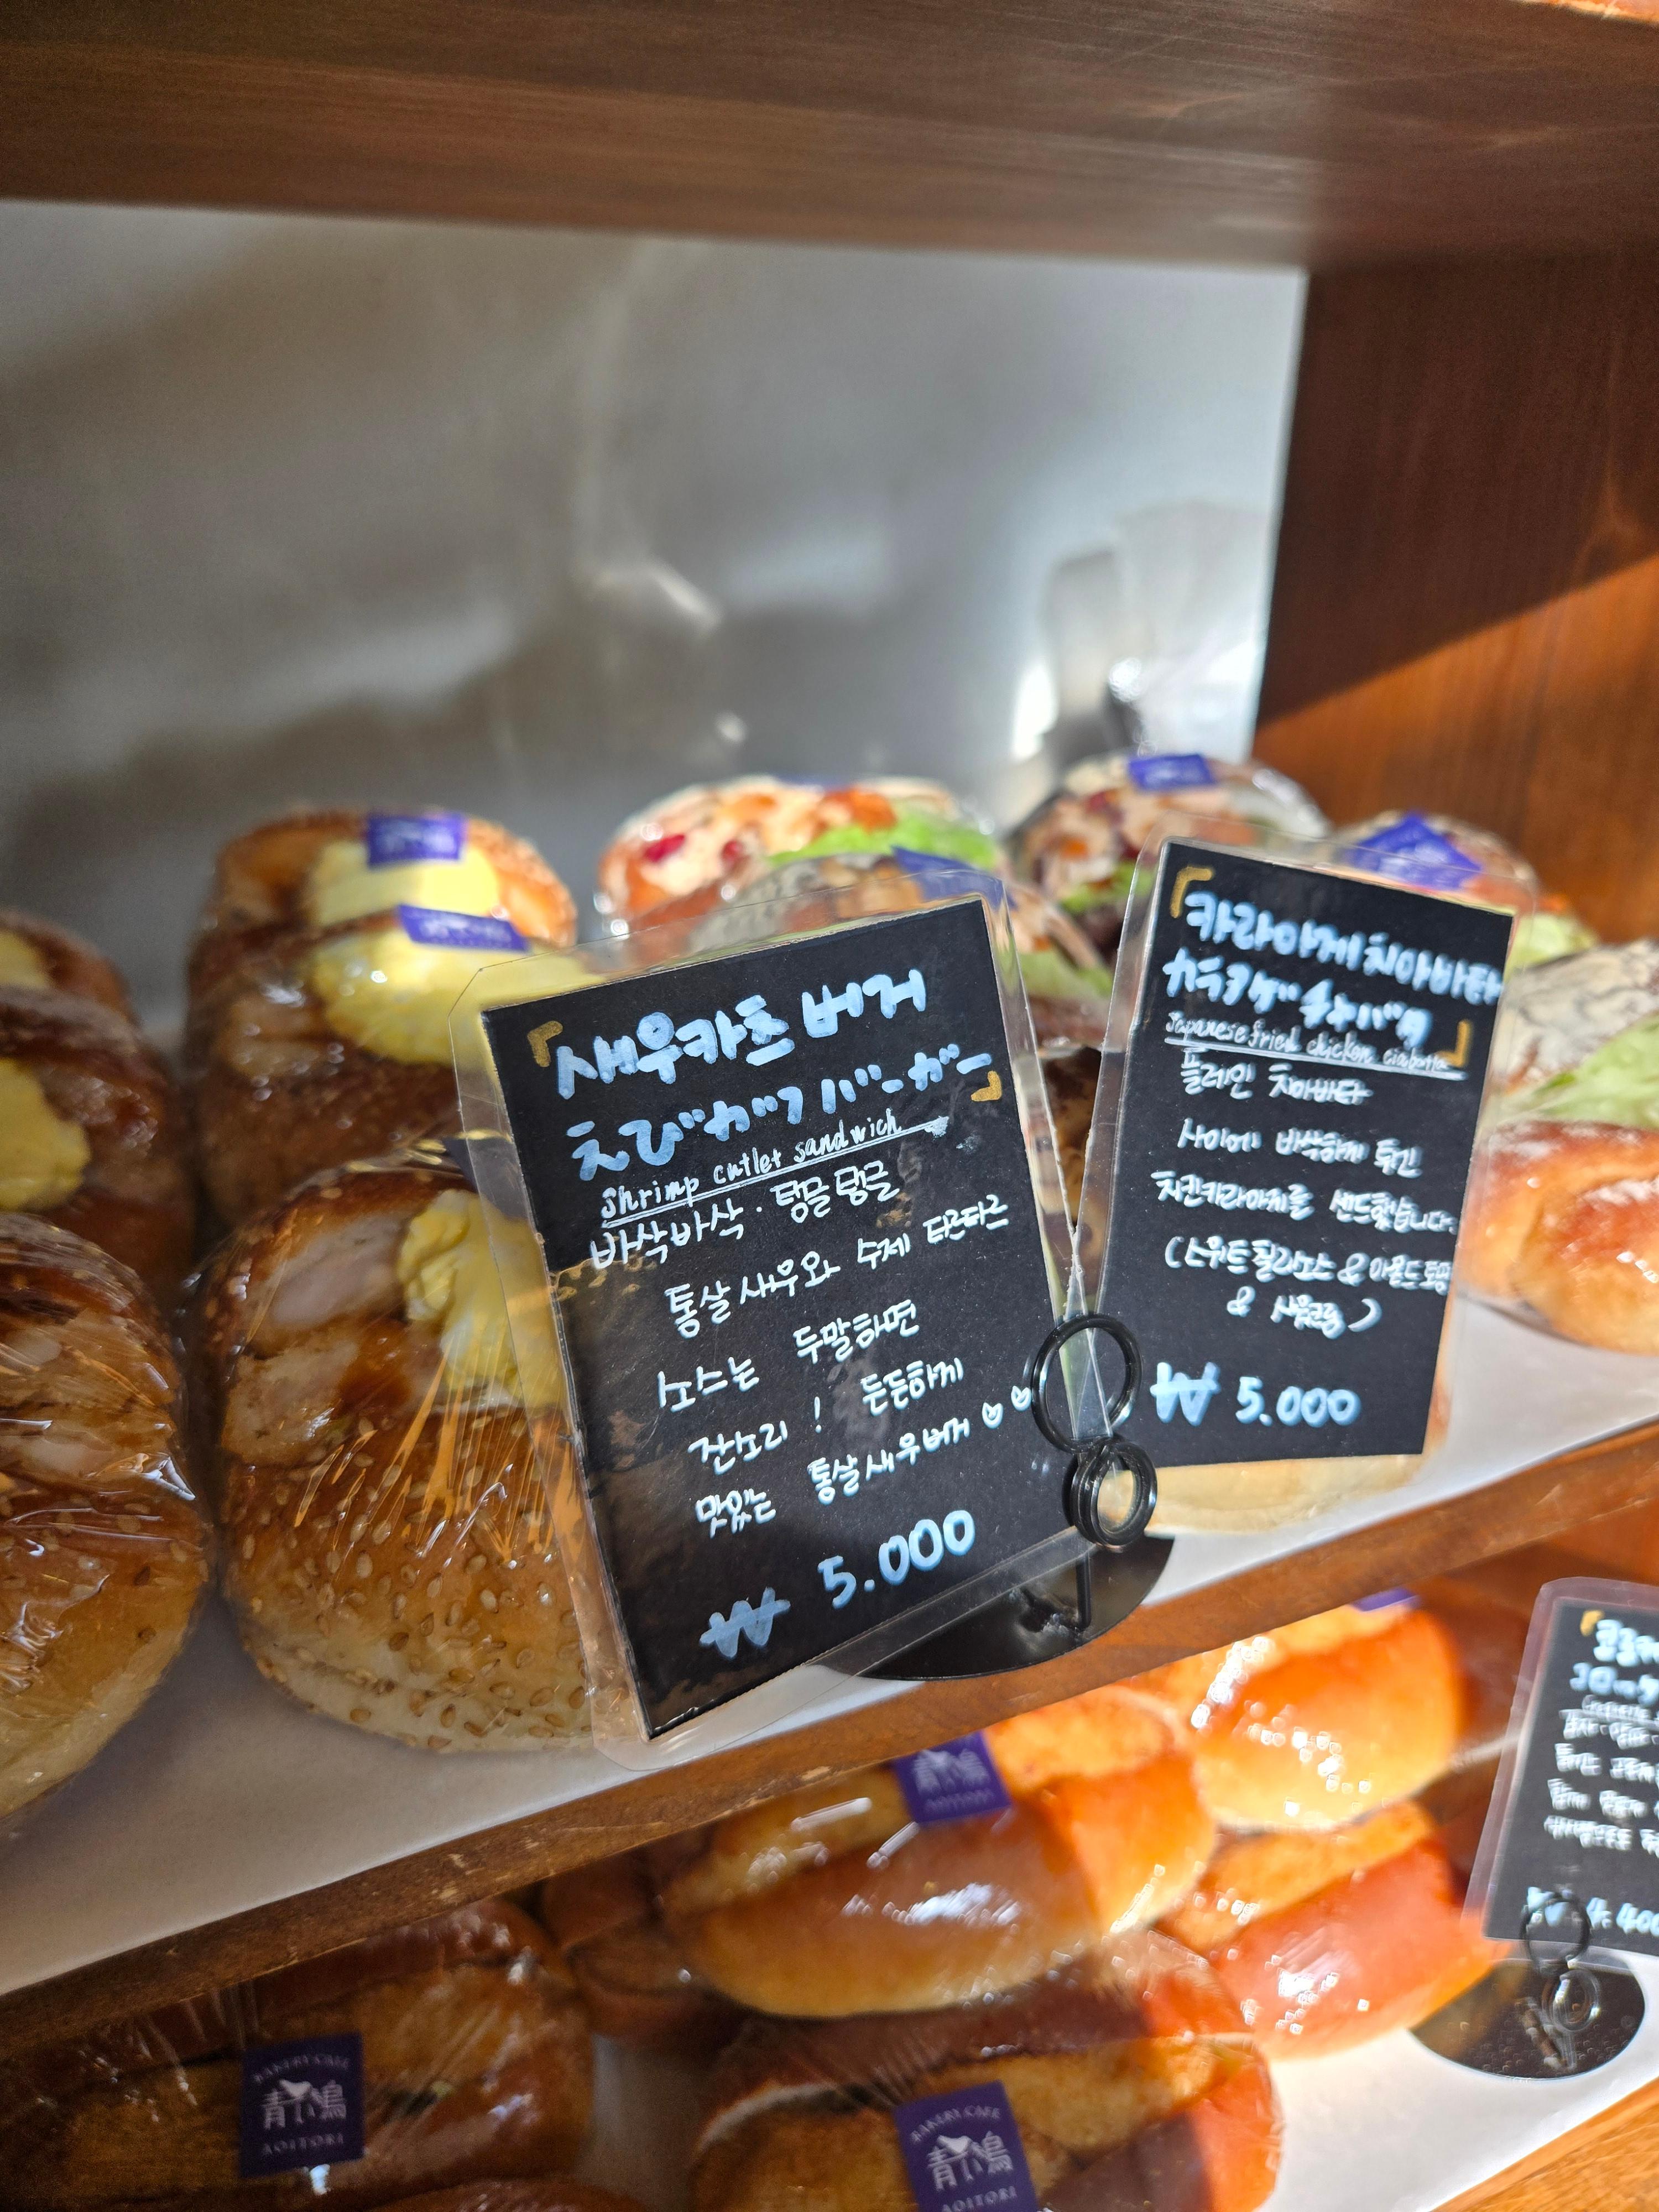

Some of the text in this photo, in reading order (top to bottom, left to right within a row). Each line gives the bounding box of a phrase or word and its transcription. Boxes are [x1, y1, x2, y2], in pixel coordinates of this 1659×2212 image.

[557, 969, 927, 1100] 새우카츠 버거
[1181, 1046, 1374, 1106] 플레인 치아바타
[713, 1147, 781, 1185] cutlet
[794, 1107, 902, 1162] sandwich
[1177, 1117, 1263, 1154] 사이에
[1374, 1137, 1426, 1179] 튀긴
[590, 1197, 744, 1269] 바삭바삭
[857, 1233, 911, 1269] 수제
[922, 1194, 1010, 1244] 타르타르
[658, 1299, 920, 1412] 소스는 두말하면
[687, 1420, 789, 1475] 잔소리
[860, 1357, 964, 1416] 든든하게
[1235, 1375, 1363, 1427] 5.000
[695, 1488, 776, 1539] 맛있는
[817, 1510, 976, 1609] 5.000
